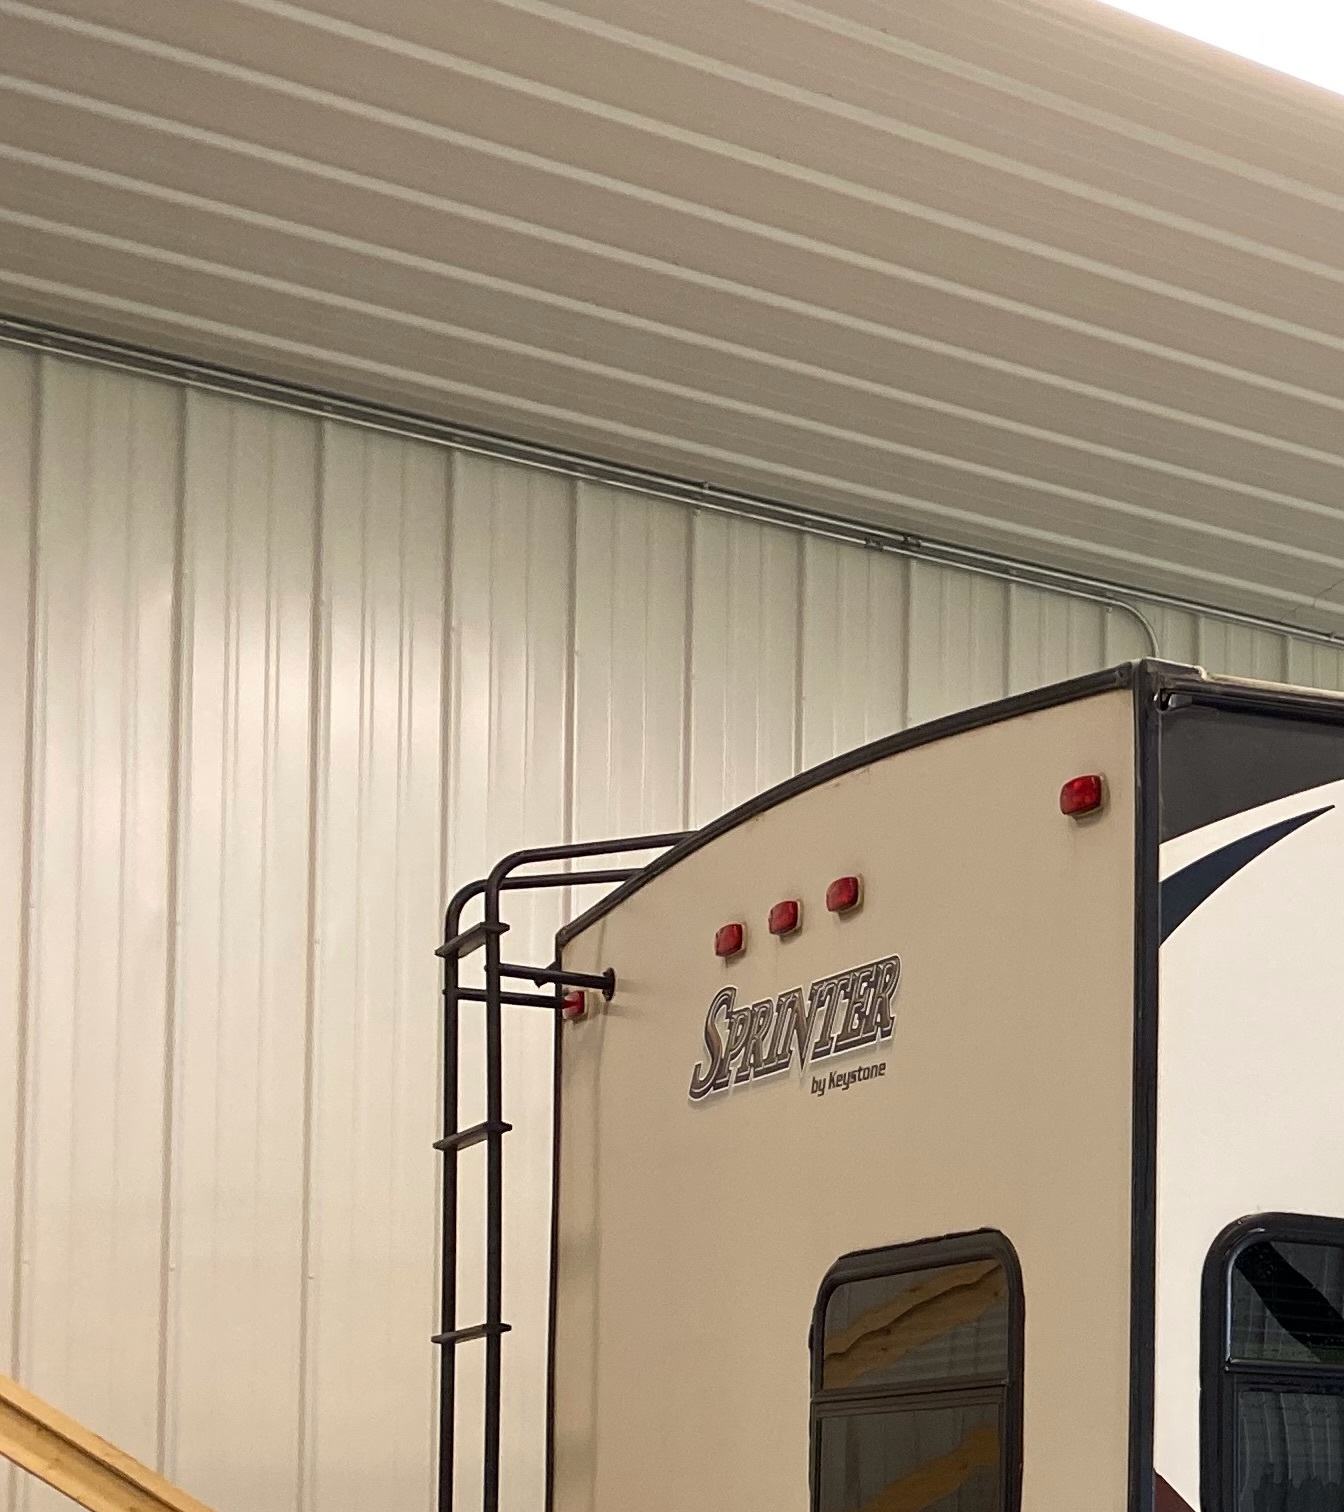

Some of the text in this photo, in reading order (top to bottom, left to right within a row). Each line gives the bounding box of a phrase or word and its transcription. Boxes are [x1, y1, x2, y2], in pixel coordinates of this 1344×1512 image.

[689, 954, 900, 1100] SPRINTER
[811, 1062, 887, 1097] by Keystone
